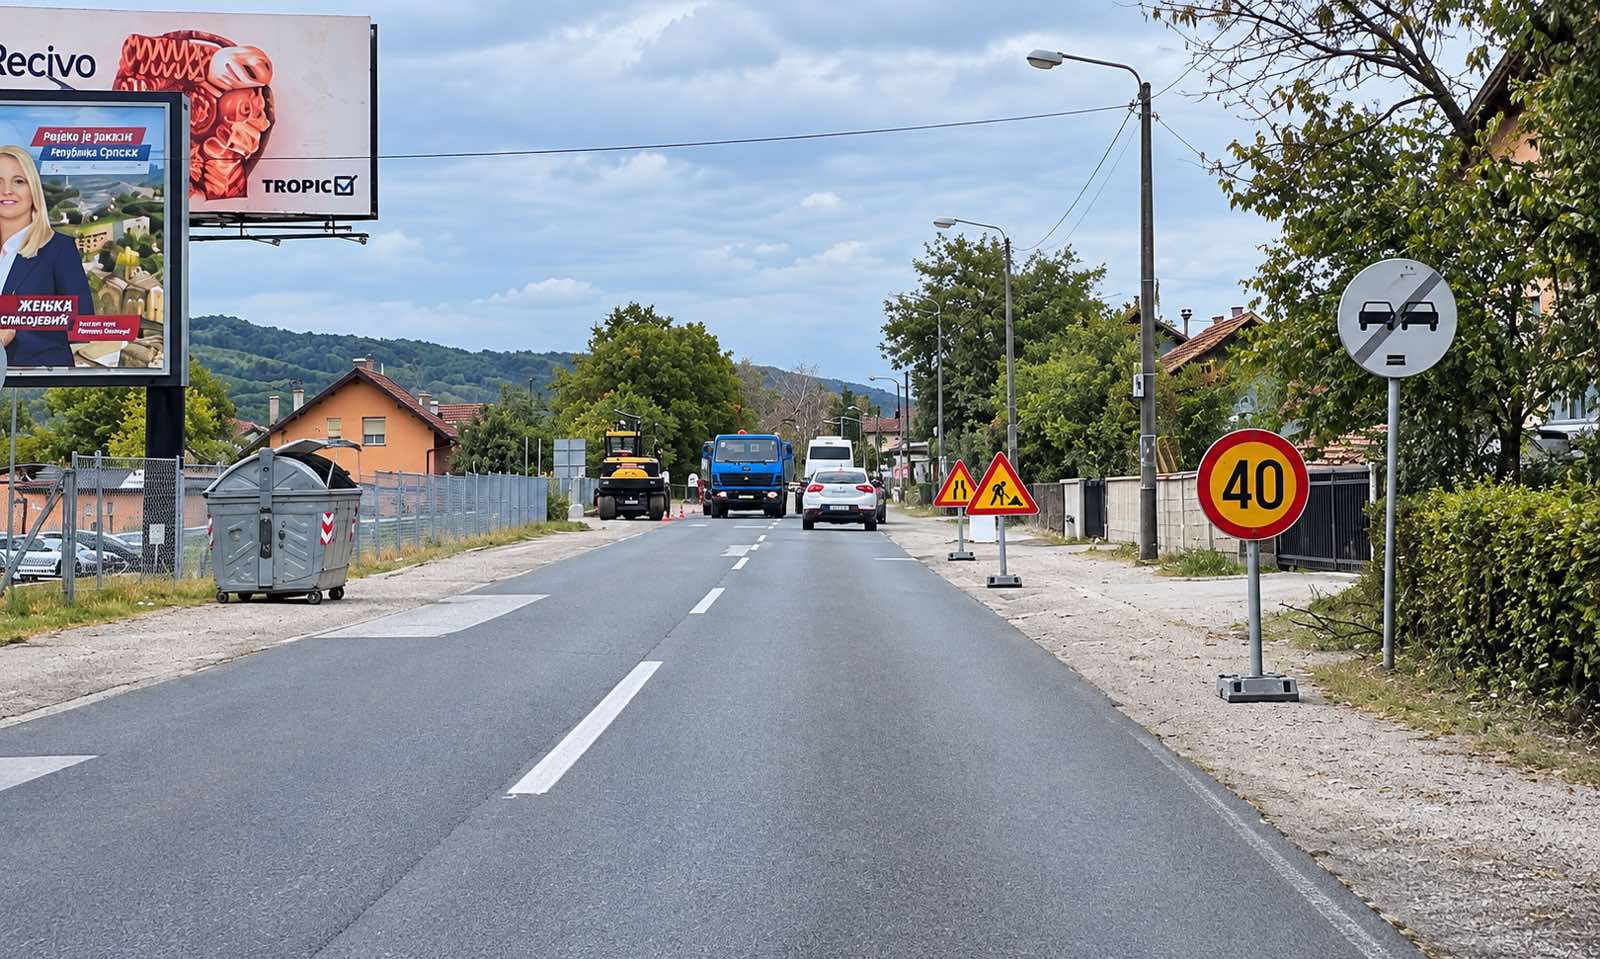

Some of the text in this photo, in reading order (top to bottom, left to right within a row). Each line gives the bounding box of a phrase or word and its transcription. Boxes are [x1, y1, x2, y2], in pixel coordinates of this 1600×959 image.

[262, 179, 332, 193] TROPIC
[18, 299, 72, 312] ЖЕЊКА
[1223, 459, 1284, 510] 40
